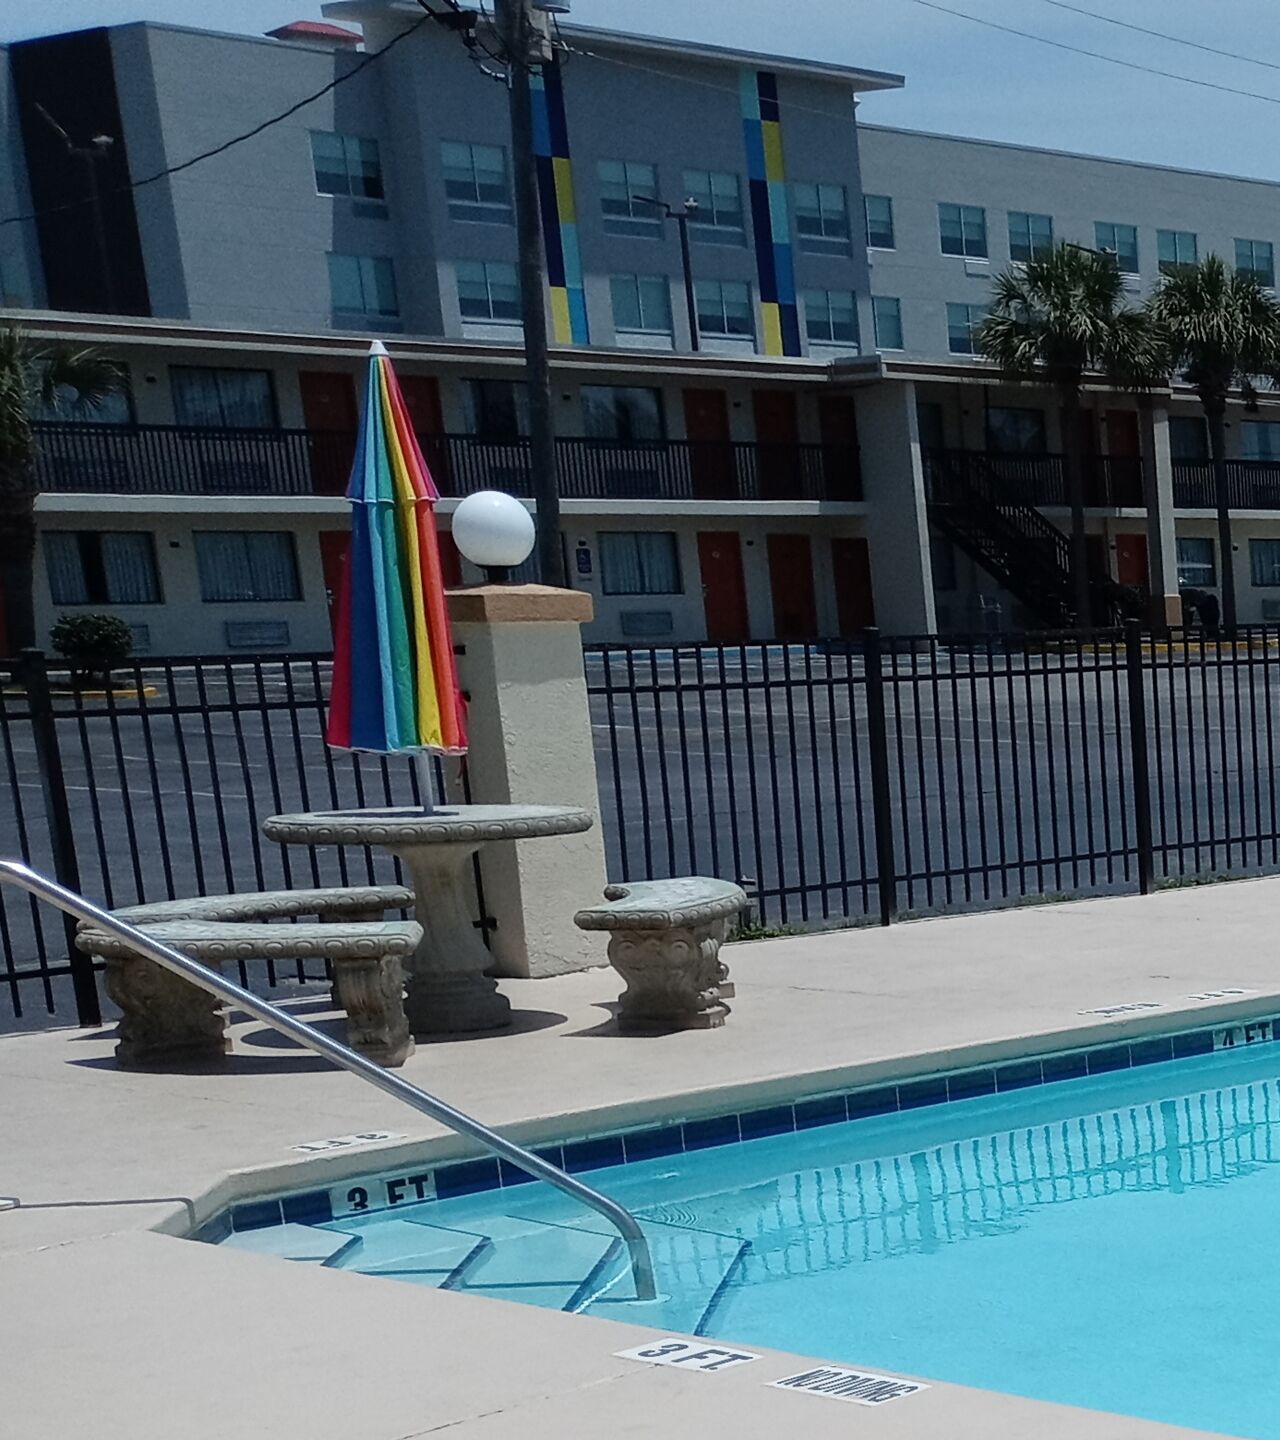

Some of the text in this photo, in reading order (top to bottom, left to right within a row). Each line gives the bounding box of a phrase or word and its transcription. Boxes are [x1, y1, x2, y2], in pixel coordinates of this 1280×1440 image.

[1244, 1022, 1270, 1043] FT
[347, 1186, 368, 1212] 3
[637, 1343, 688, 1357] 3
[808, 1374, 919, 1403] DIVING
